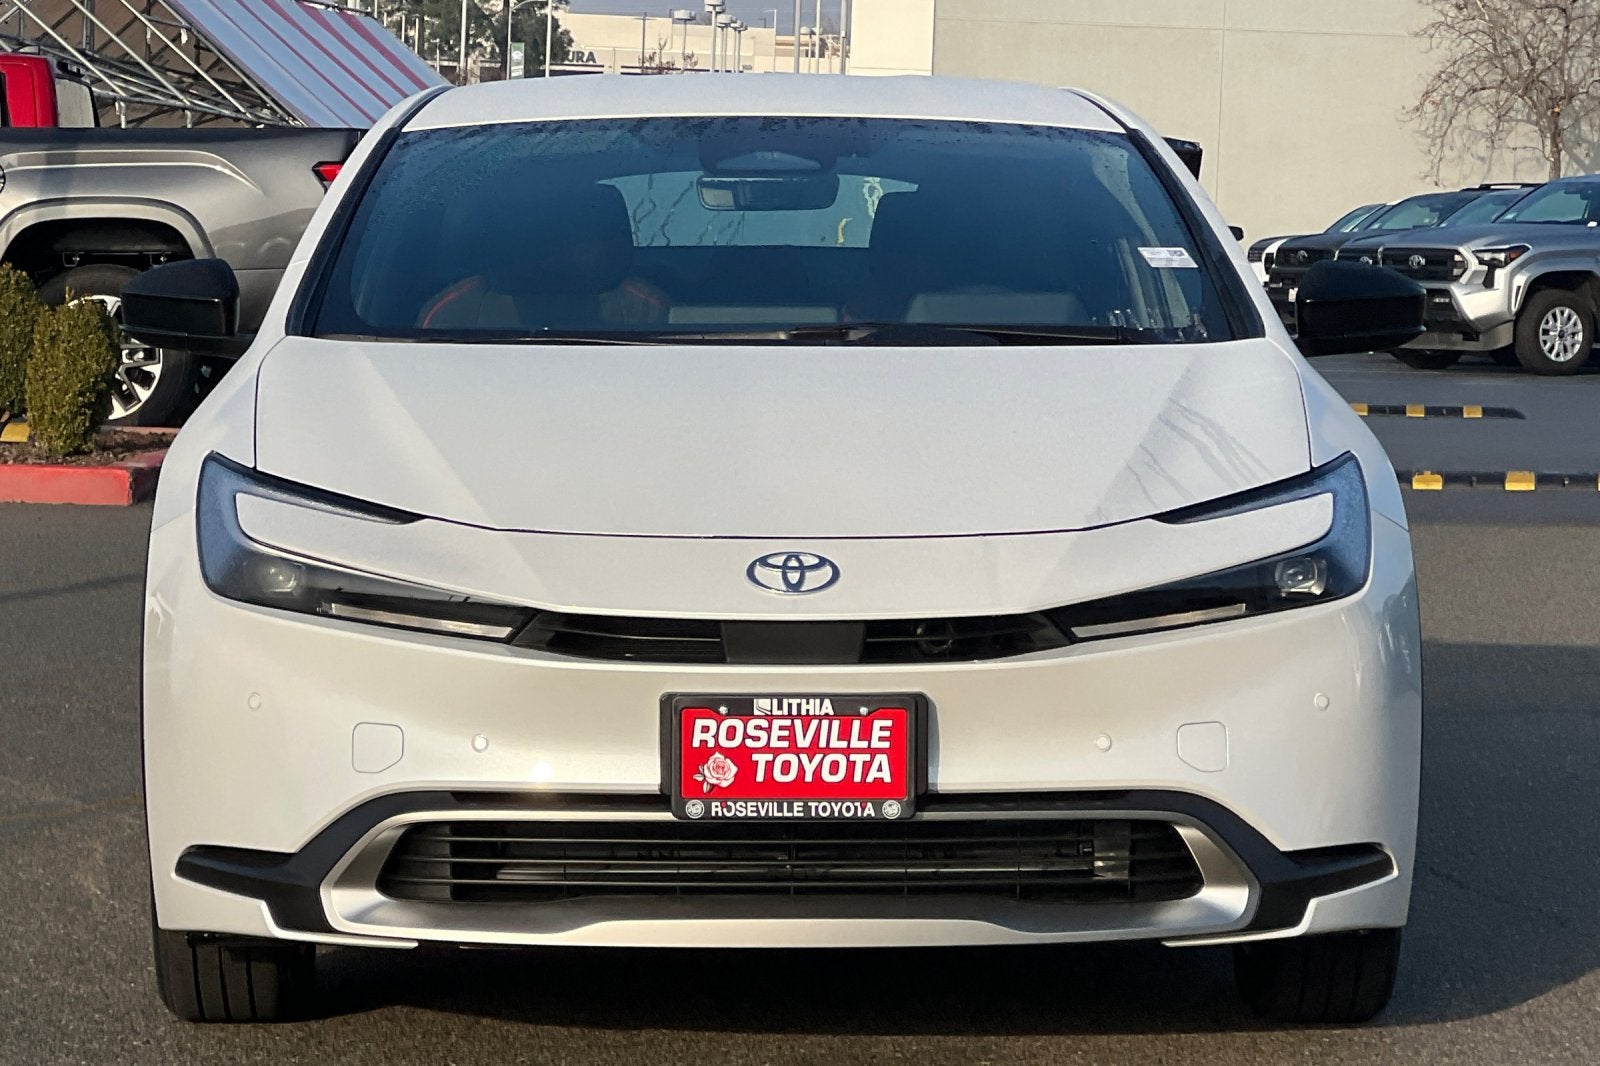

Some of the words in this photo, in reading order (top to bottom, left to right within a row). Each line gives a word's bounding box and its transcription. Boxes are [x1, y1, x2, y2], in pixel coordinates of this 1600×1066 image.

[567, 50, 597, 63] URA
[772, 699, 834, 716] LITHIA
[691, 718, 893, 749] ROSEVILLE
[751, 753, 892, 783] TOYOTA
[711, 801, 804, 817] ROSEVILLE
[808, 801, 875, 817] TOYOTA
